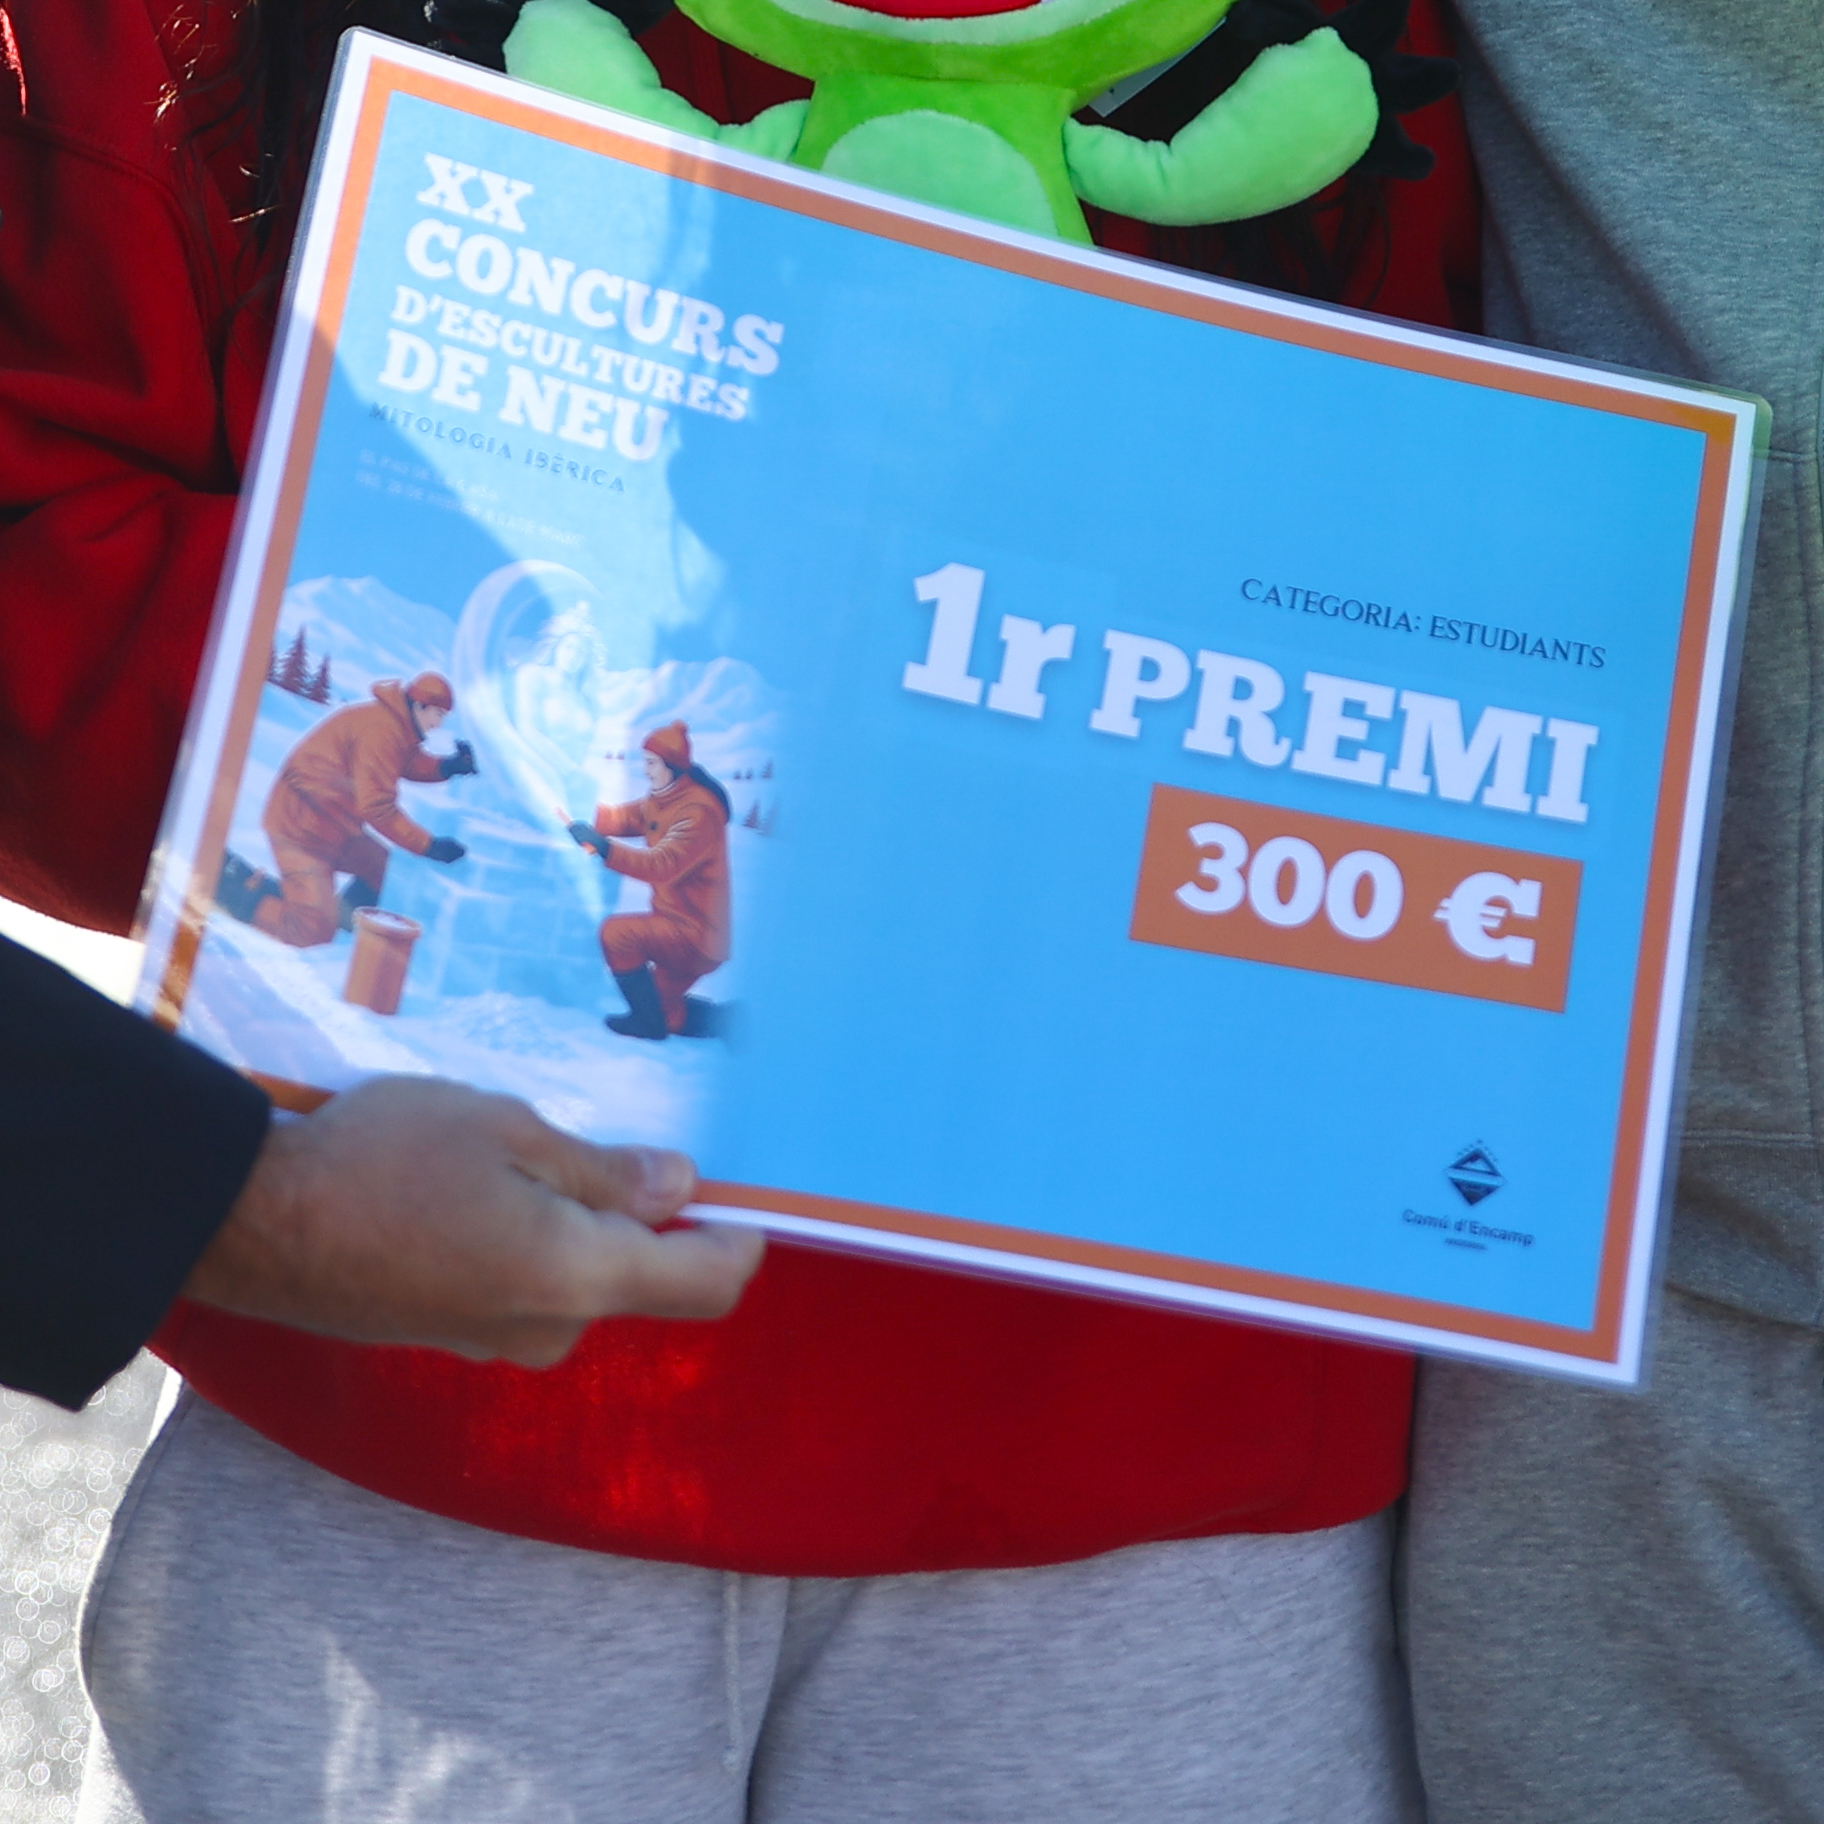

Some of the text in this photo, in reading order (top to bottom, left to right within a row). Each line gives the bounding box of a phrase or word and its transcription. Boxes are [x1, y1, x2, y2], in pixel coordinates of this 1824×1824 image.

[417, 152, 534, 233] XX
[390, 285, 749, 421] D'ESCULTURES
[405, 218, 785, 375] CONCURS
[369, 401, 513, 460] MITOLOGIA
[378, 328, 669, 461] DE NEU
[1241, 578, 1607, 669] CATEGORIA: ESTUDIANTS
[902, 562, 1600, 824] 1r PREMI
[1174, 821, 1543, 966] 300 €
[1402, 1208, 1449, 1230] Comú
[1454, 1217, 1535, 1246] d'Encamp
